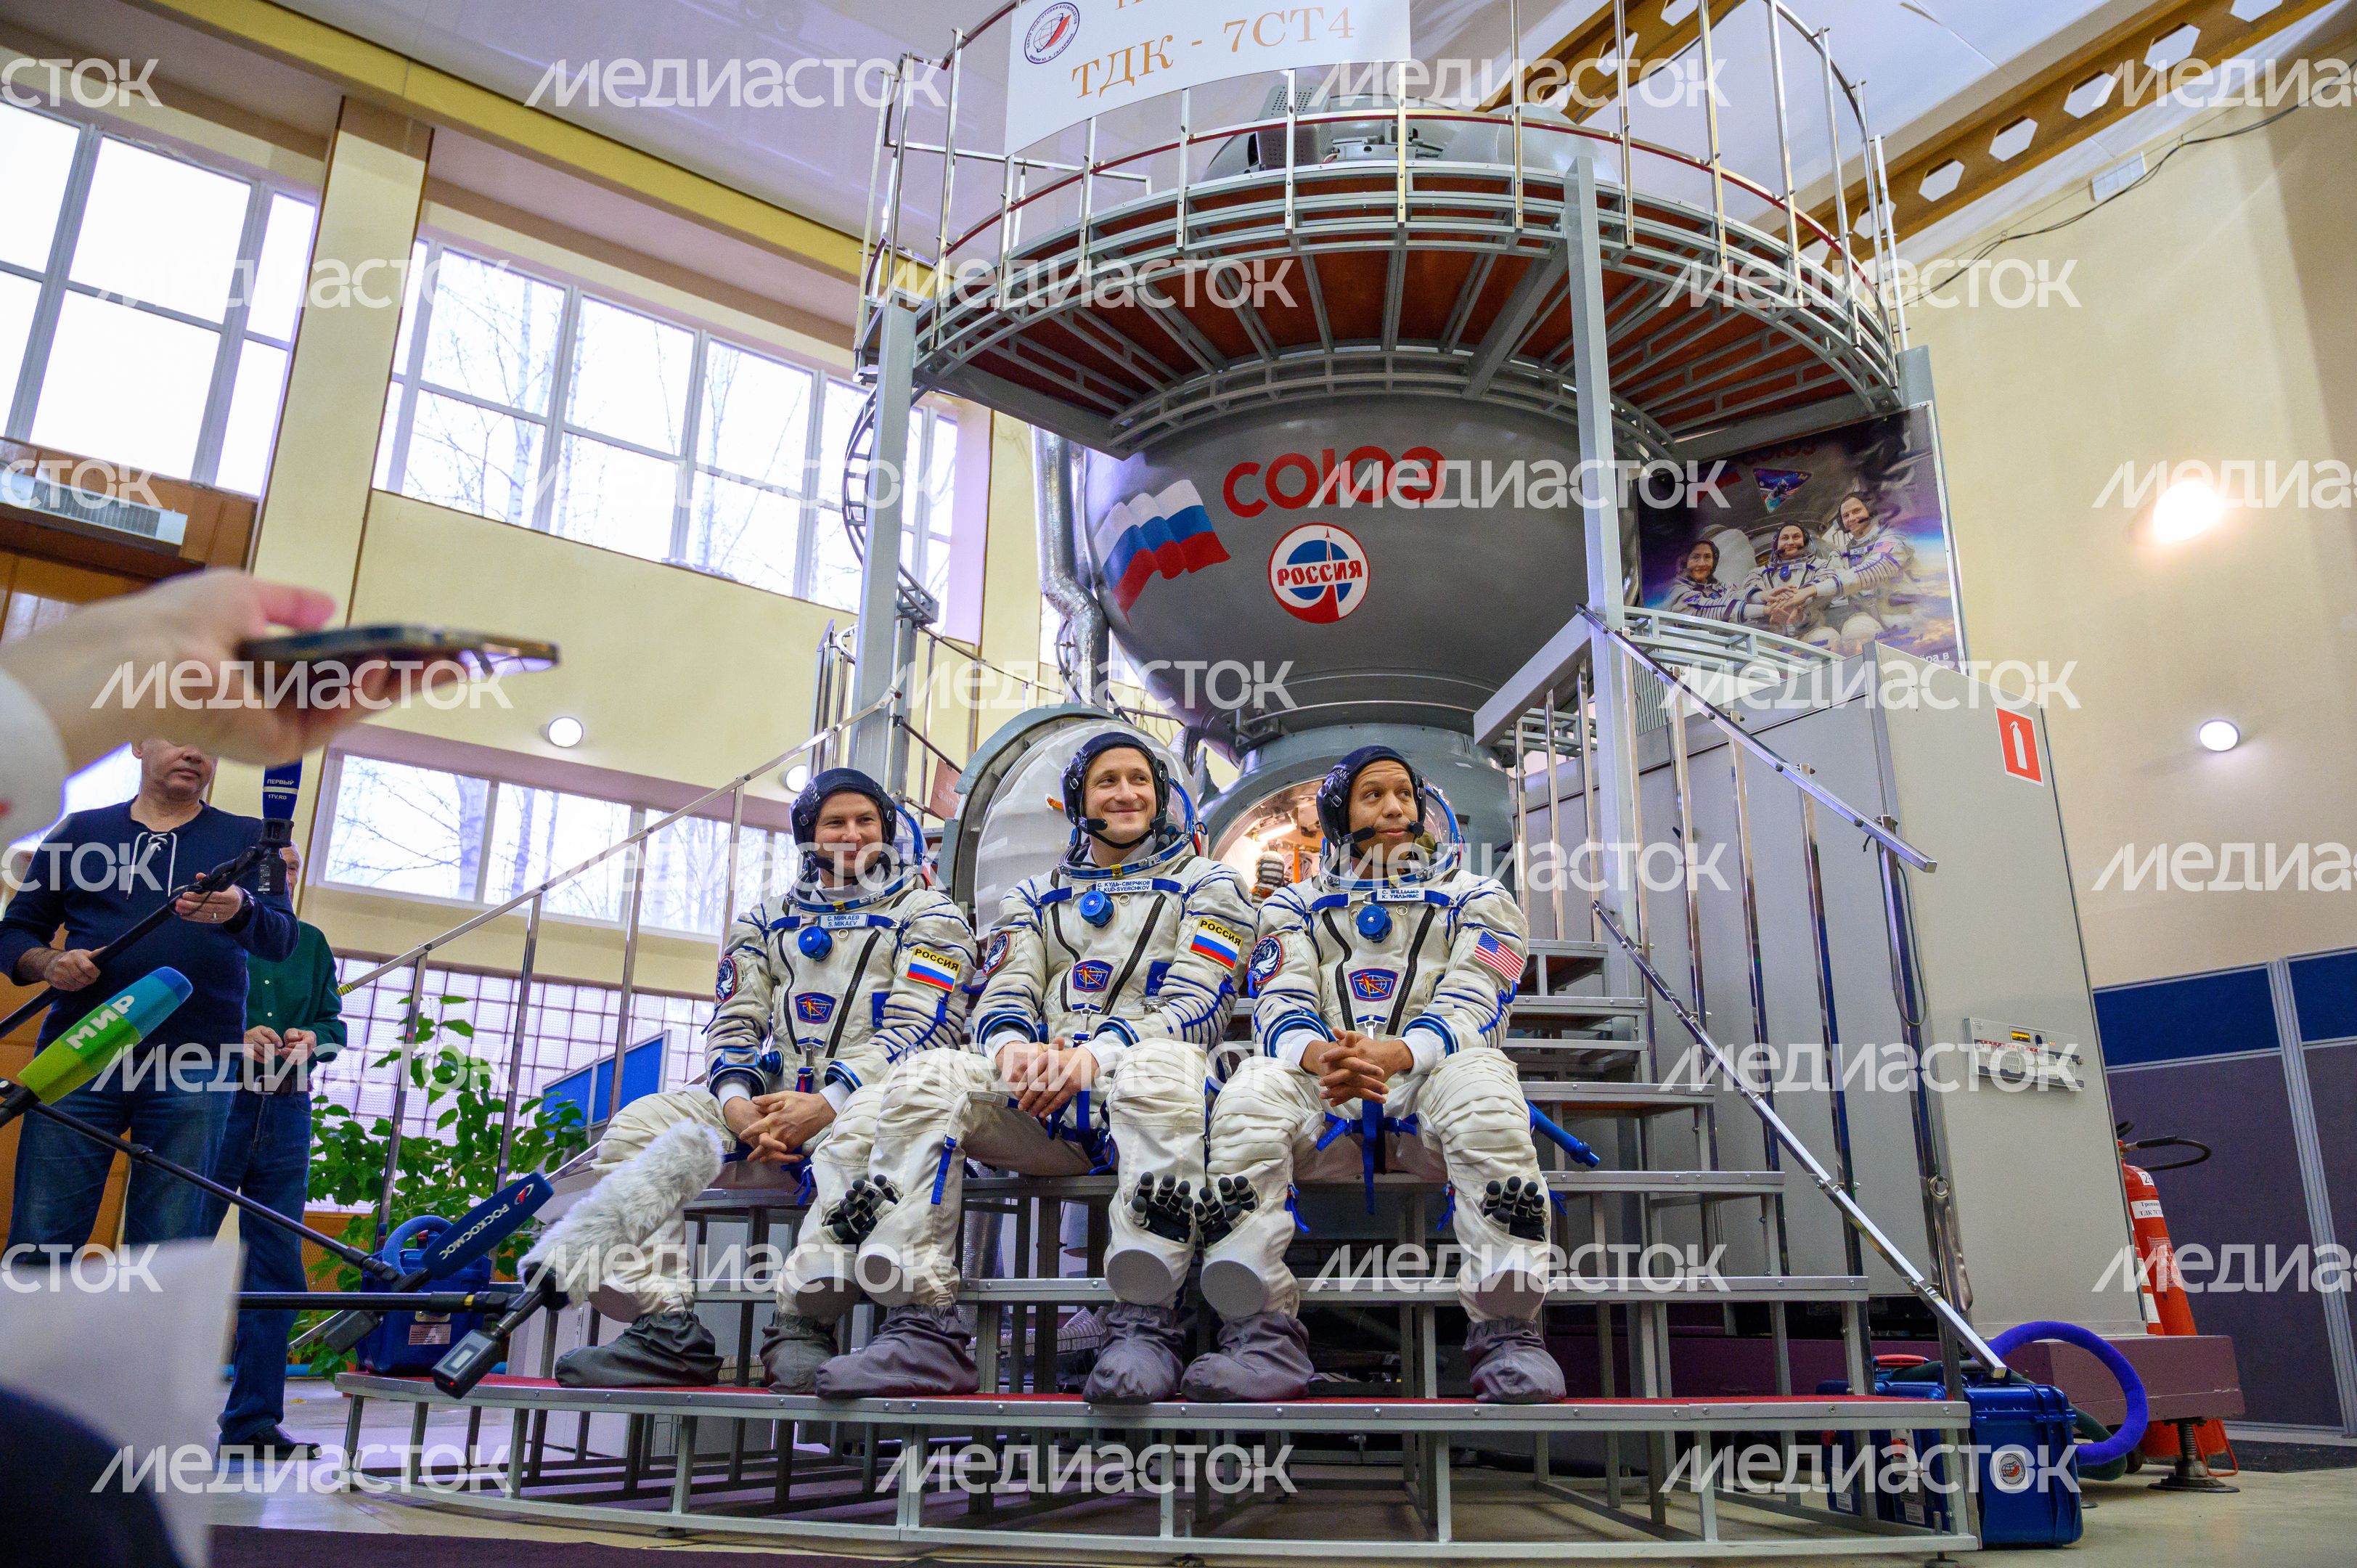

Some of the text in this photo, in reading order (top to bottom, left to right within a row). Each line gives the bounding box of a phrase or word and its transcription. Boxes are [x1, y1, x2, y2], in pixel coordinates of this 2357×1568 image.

[1072, 35, 1174, 98] ТДК
[1224, 7, 1355, 53] 7СТ4
[1223, 446, 1447, 518] СОЮЗ
[1277, 560, 1363, 586] РОССИЯ
[915, 948, 960, 971] РОССИЯ
[1200, 920, 1242, 947] РОССИЯ
[66, 995, 135, 1050] МИР
[438, 1204, 510, 1260] РОСКОСМОС
